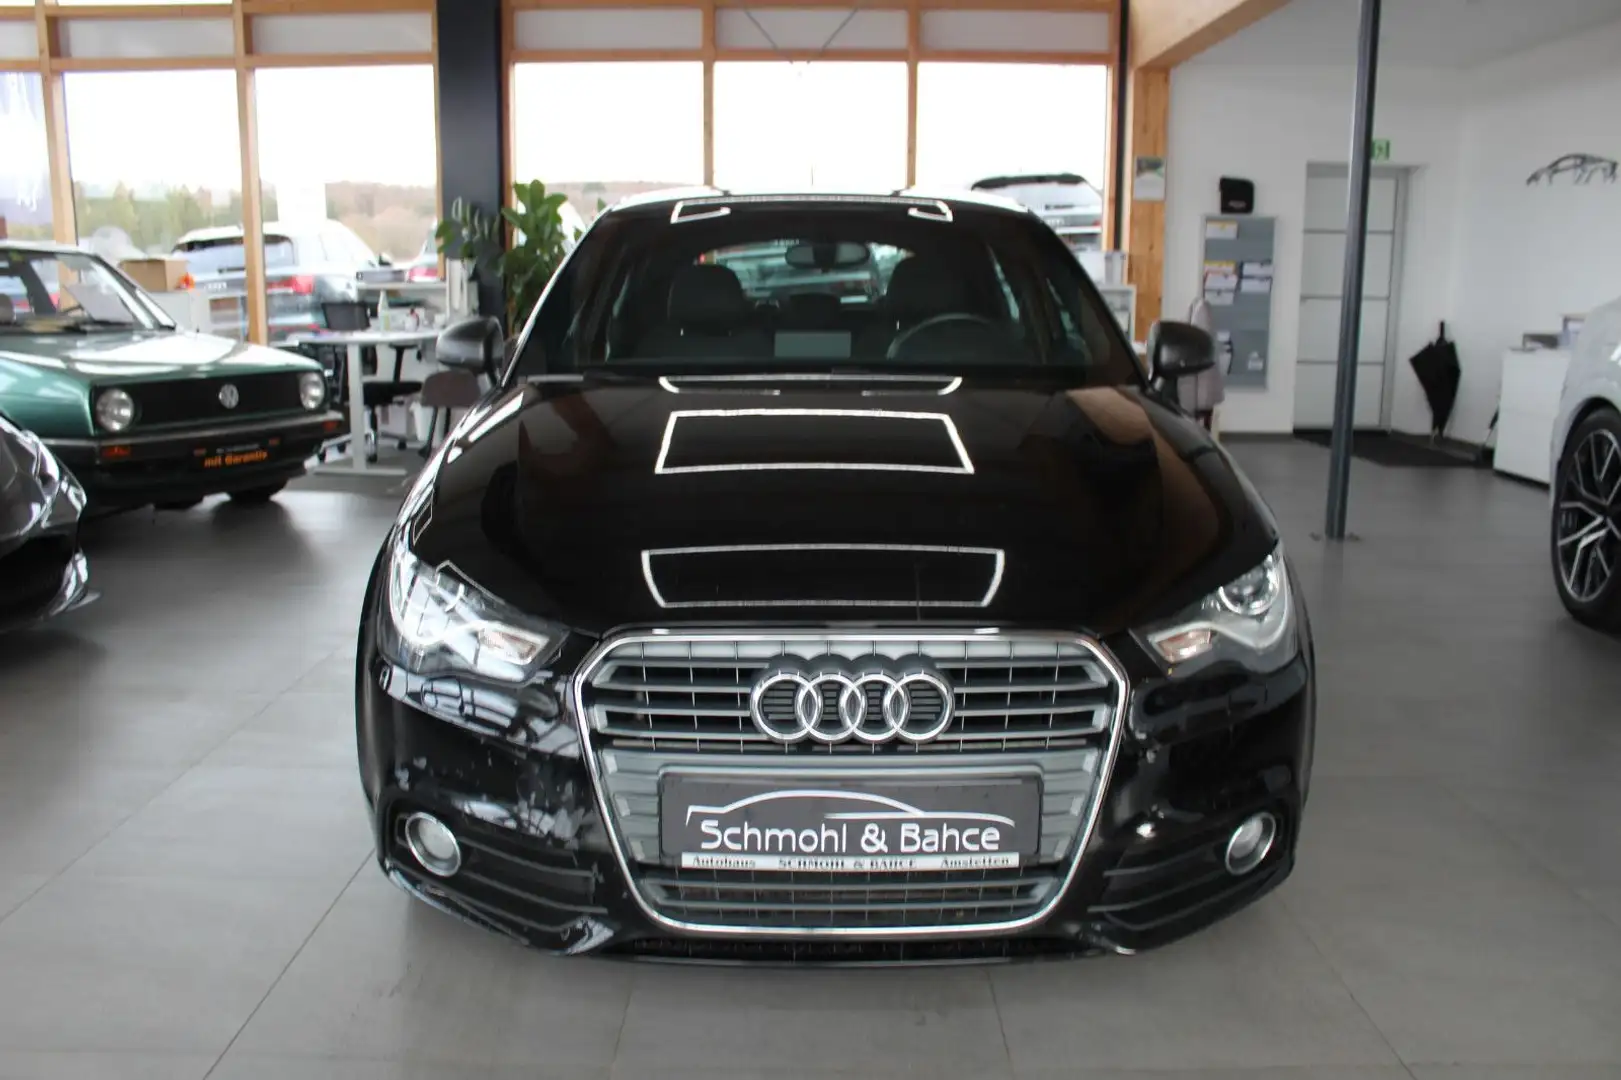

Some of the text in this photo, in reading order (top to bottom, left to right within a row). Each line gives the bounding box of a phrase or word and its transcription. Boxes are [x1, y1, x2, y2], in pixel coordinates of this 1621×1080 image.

[700, 819, 1001, 853] Schmohl & Bahce
[692, 855, 756, 869] Autohaus
[853, 859, 864, 870] &
[870, 857, 917, 871] BAHCE
